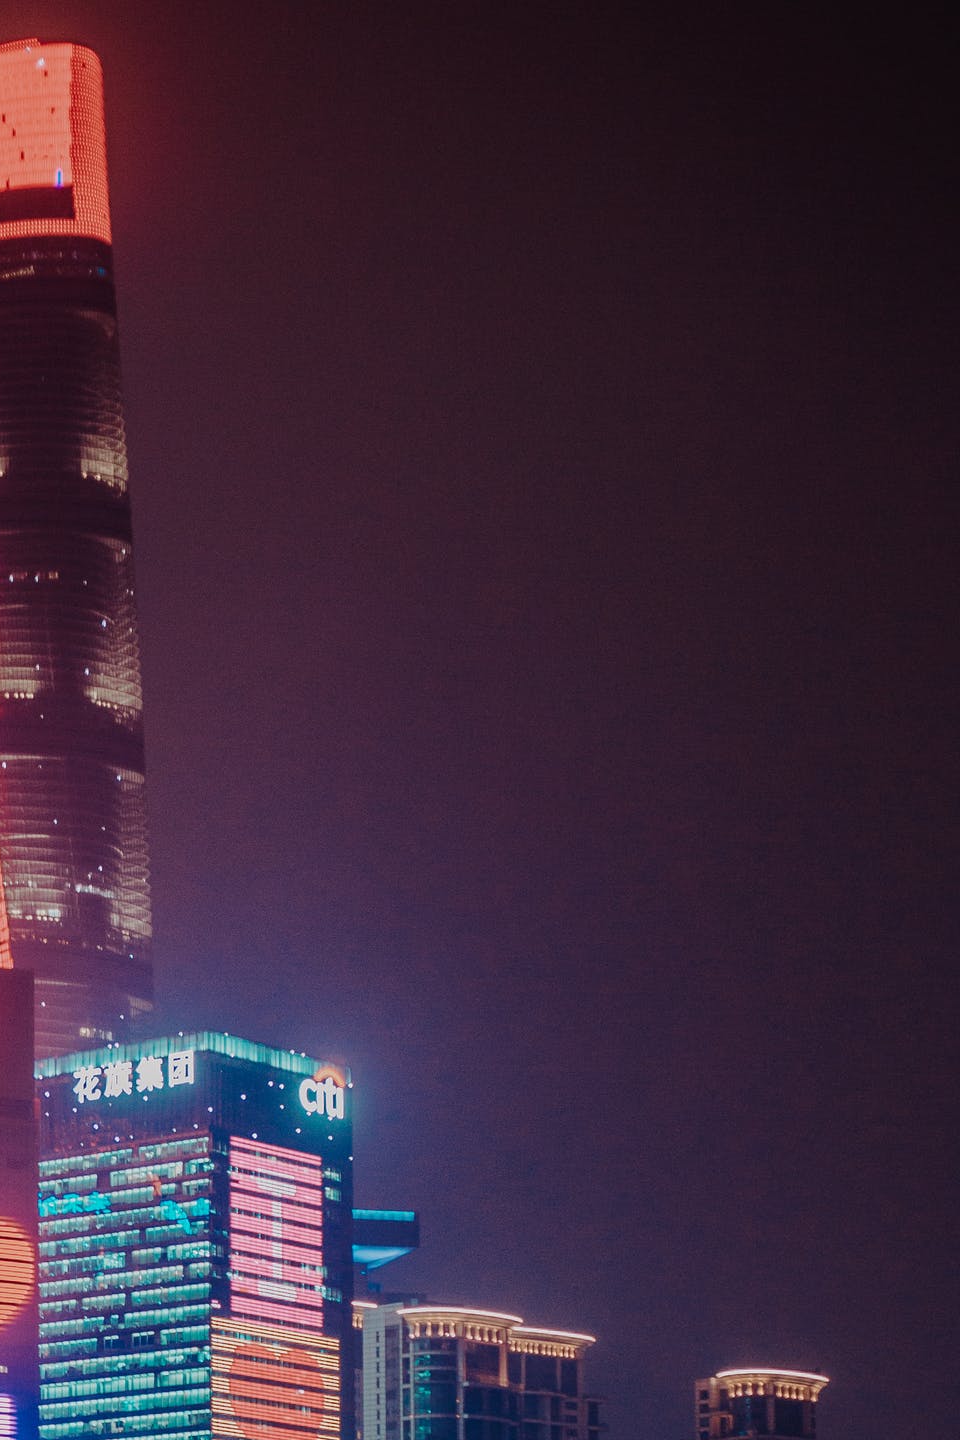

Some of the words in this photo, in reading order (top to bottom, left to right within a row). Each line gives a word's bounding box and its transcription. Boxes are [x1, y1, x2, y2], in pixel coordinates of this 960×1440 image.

[73, 1050, 195, 1103] 花旗集团
[298, 1075, 346, 1120] citi
